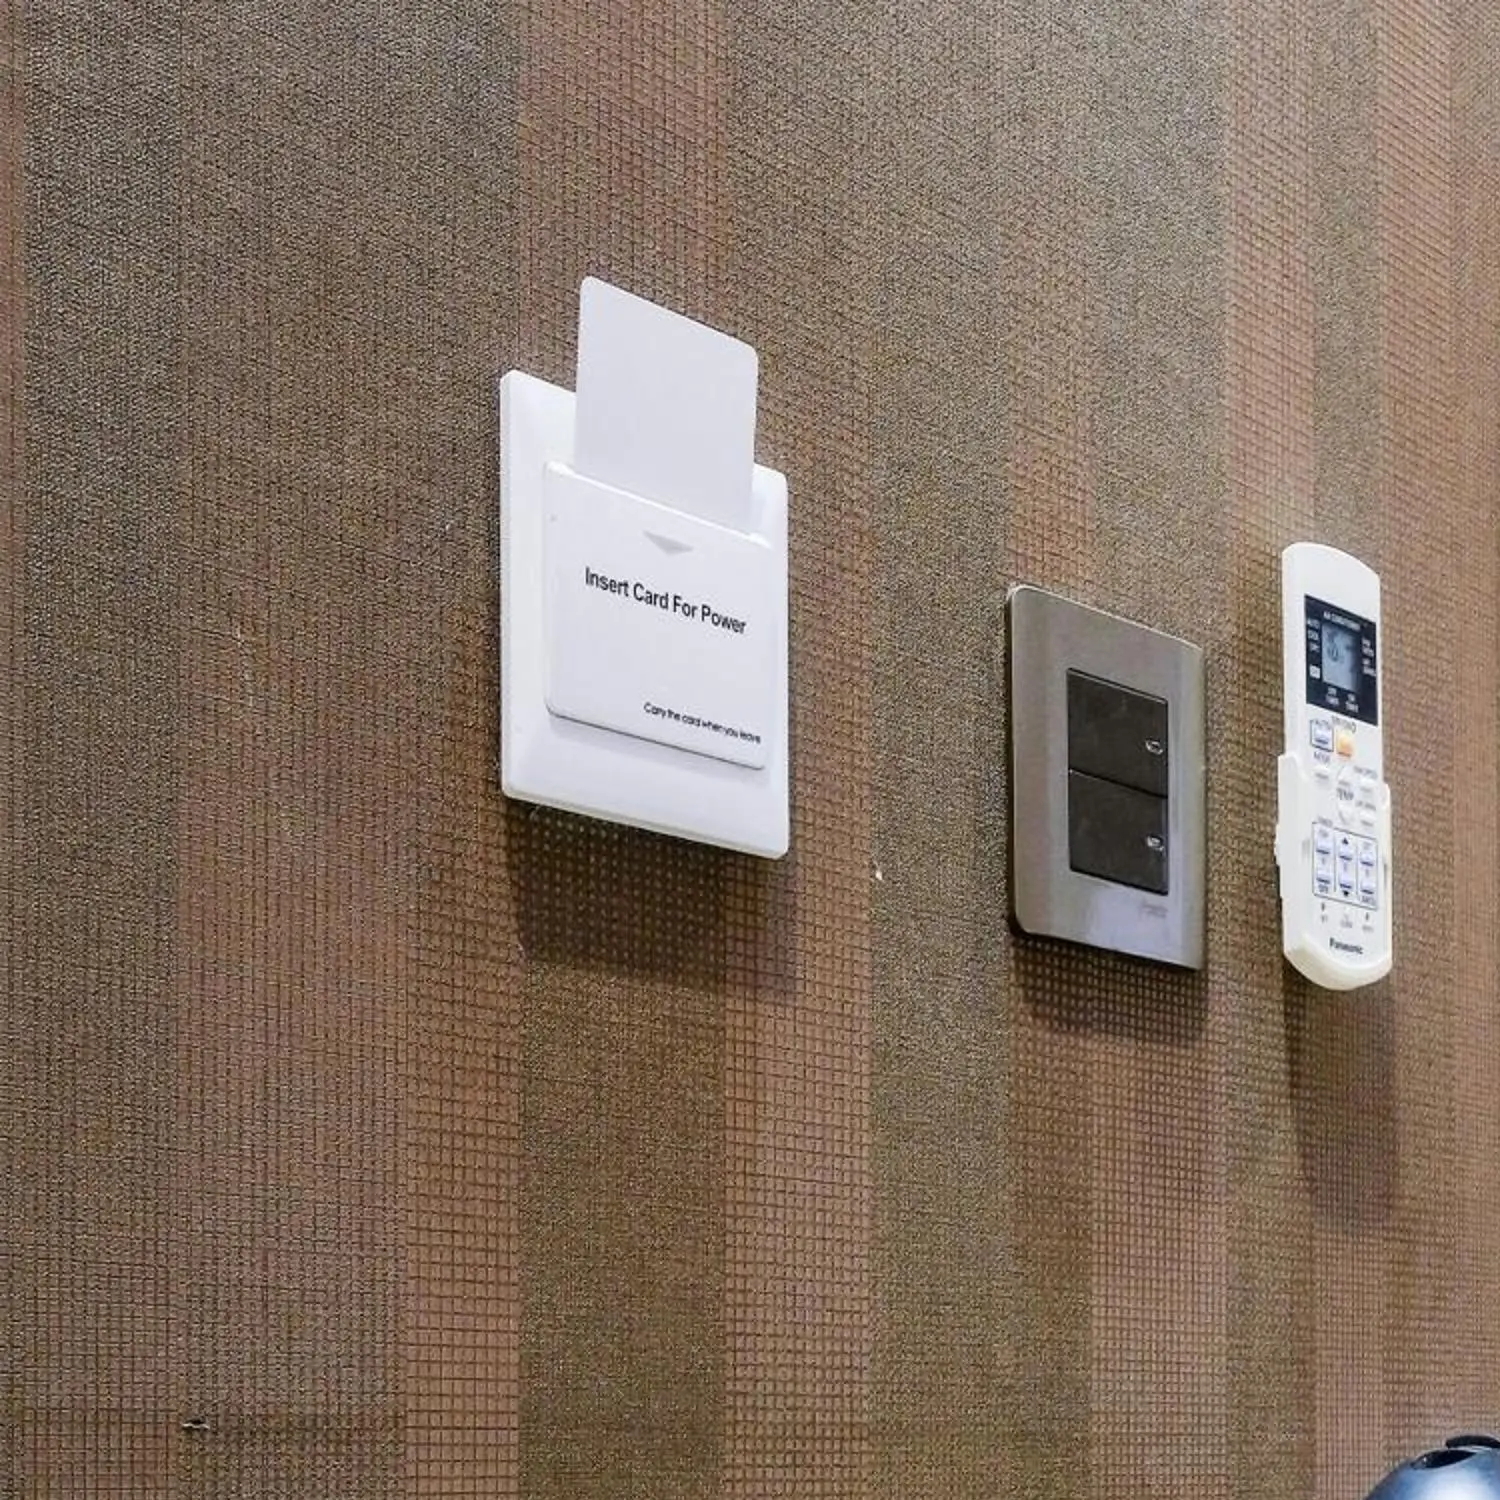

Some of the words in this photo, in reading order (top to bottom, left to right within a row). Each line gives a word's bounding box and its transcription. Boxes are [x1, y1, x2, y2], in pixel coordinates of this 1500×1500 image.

[585, 566, 629, 597] Insert
[633, 582, 669, 610] Card
[673, 594, 698, 618] For
[701, 604, 747, 634] Power
[682, 715, 701, 727] card
